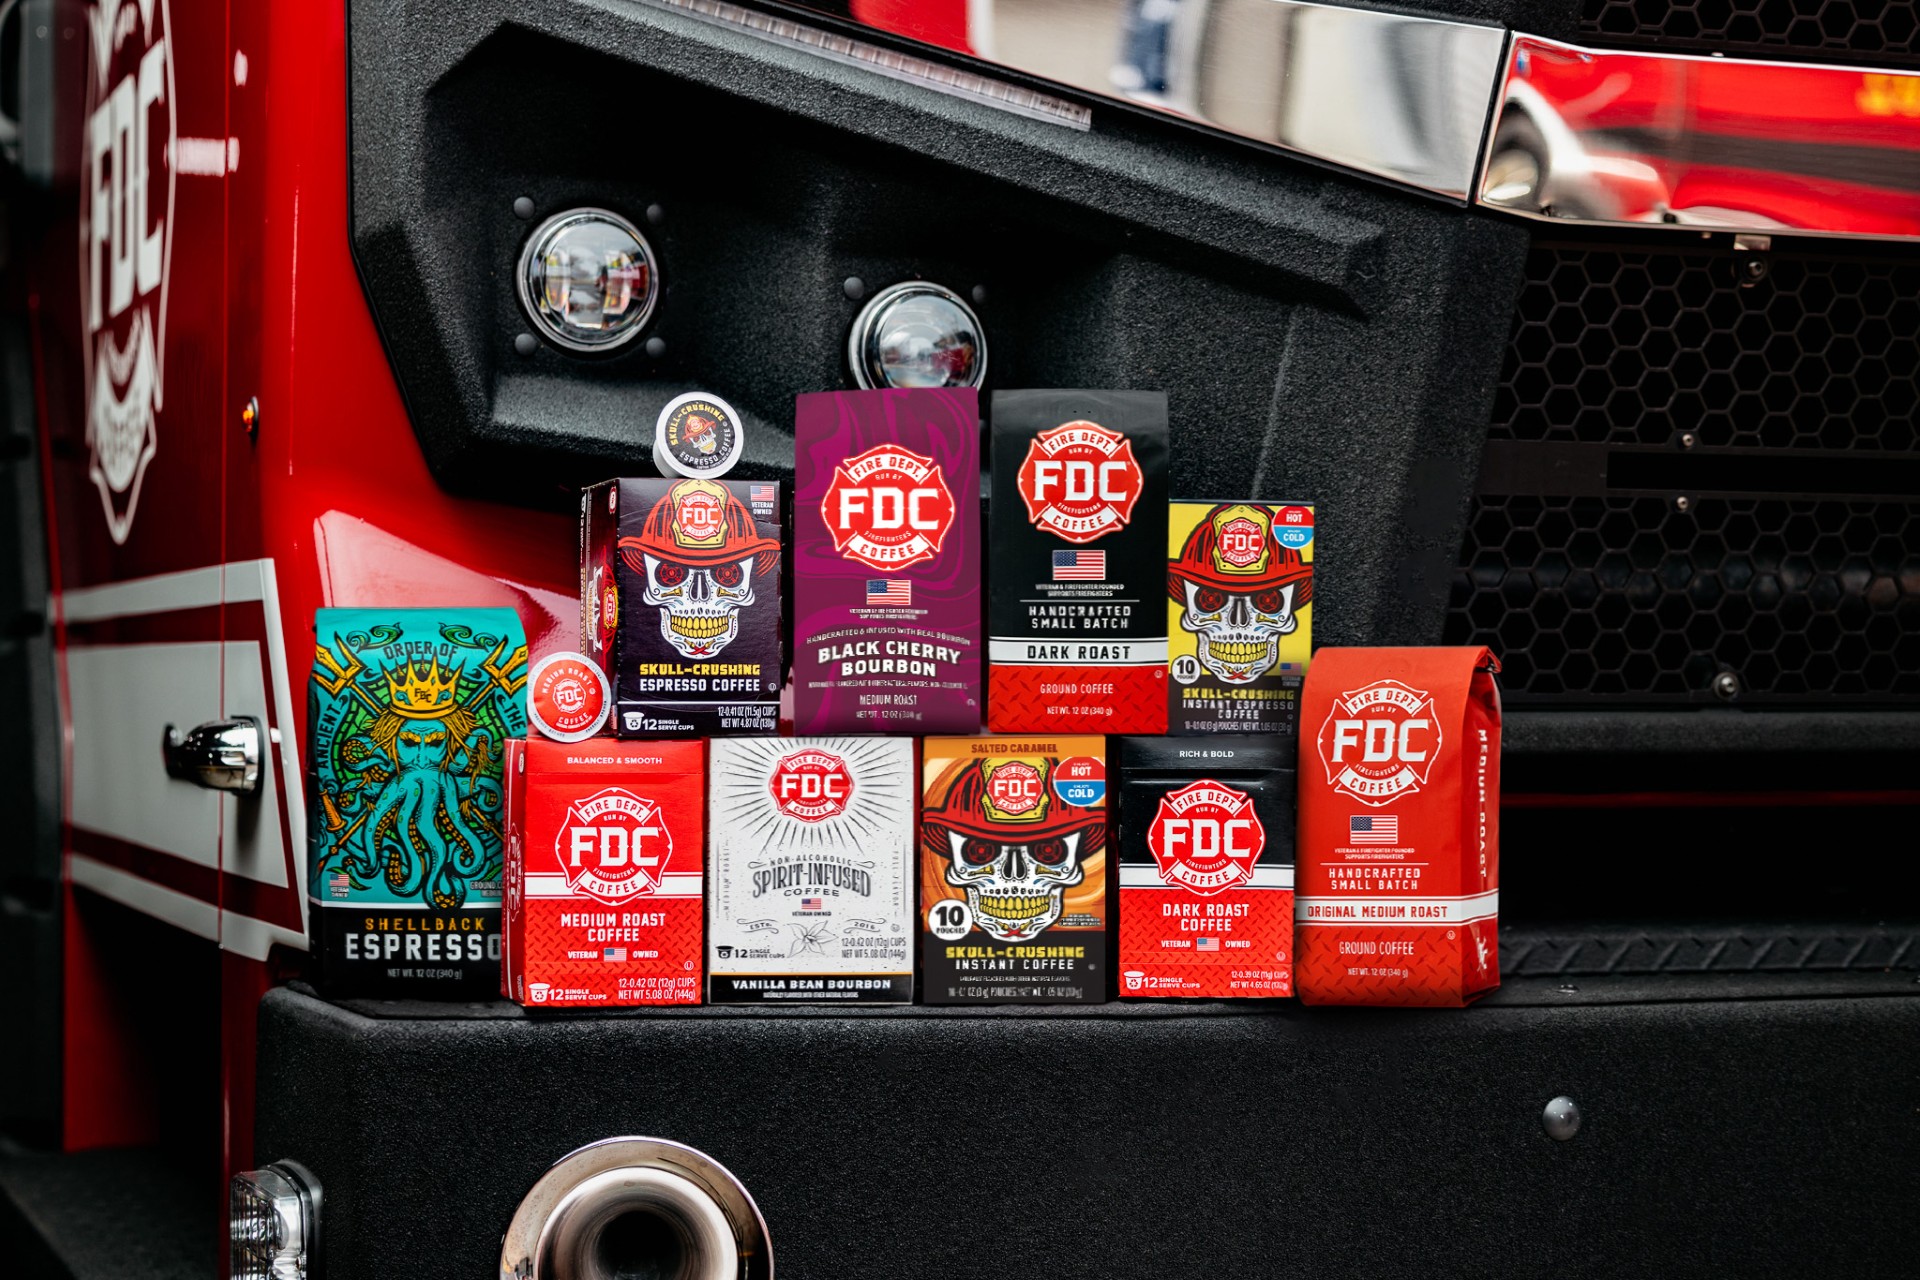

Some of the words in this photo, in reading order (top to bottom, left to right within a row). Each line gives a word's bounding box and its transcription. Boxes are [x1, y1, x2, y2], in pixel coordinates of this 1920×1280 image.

[90, 38, 164, 332] FDC
[668, 403, 725, 446] SKULL-CRUSHING
[680, 452, 719, 466] ESPRESSO
[719, 429, 731, 457] COFFEE
[1049, 432, 1074, 450] FIRE
[1082, 432, 1110, 451] DEPT.
[854, 458, 881, 477] FIRE
[890, 457, 920, 477] DEPT.
[1033, 461, 1127, 501] FDC
[839, 487, 939, 529] FDC
[1057, 502, 1101, 514] FIREFIGHTERS
[682, 508, 719, 524] FDC
[1286, 514, 1303, 522] HOT
[1053, 516, 1104, 530] COFFEE
[864, 531, 912, 542] FIREFIGHTERS
[1223, 534, 1260, 550] FDC
[1283, 533, 1305, 541] COLD
[860, 544, 915, 558] COFFEE
[1029, 606, 1131, 616] HANDCRAFTED
[1032, 618, 1075, 628] SMALL
[1084, 618, 1128, 628] BATCH
[807, 629, 859, 644] HANDCRAFTED
[917, 629, 934, 638] REAL
[383, 641, 433, 660] ORDER
[440, 646, 458, 659] OF
[818, 641, 880, 663] BLACK
[886, 641, 960, 664] CHERRY
[1028, 646, 1069, 659] DARK
[1078, 646, 1130, 659] ROAST
[640, 664, 760, 675] SKULL-CRUSHING
[842, 659, 936, 677] BOURBON
[1177, 660, 1195, 674] 10
[542, 668, 564, 693] MEDIUM
[568, 668, 592, 685] ROAST
[640, 679, 707, 691] ESPRESSO
[712, 679, 760, 691] COFFEE
[1040, 684, 1076, 693] GROUND
[1081, 684, 1113, 693] COFFEE
[1183, 688, 1294, 699] SKULL-CRUSHING
[557, 689, 582, 704] FDC
[860, 695, 891, 705] MEDIUM
[894, 695, 917, 705] ROAST
[1352, 691, 1379, 710] FIRE
[1386, 690, 1414, 710] DEPT.
[1183, 700, 1230, 708] INSTANT
[1236, 701, 1294, 709] ESPRESSO
[504, 702, 526, 732] THE
[559, 713, 589, 724] COFFEE
[1218, 710, 1259, 719] COFFEE
[644, 719, 657, 730] 12
[317, 704, 340, 769] ANCIENT
[1331, 719, 1429, 762] FDC
[972, 744, 1008, 753] SALTED
[1010, 744, 1058, 753] CARAMEL
[790, 758, 809, 768] FIRE
[812, 757, 831, 768] DEPT.
[1071, 767, 1091, 776] HOT
[1355, 763, 1399, 776] FIREFIGHTERS
[780, 774, 843, 797] FDC
[994, 780, 1036, 796] FDC
[1349, 777, 1402, 794] COFFEE
[1068, 789, 1094, 798] COLD
[1177, 792, 1201, 809] FIRE
[1208, 792, 1233, 810] DEPT.
[585, 800, 609, 817] FIRE
[616, 800, 642, 817] DEPT.
[793, 805, 828, 815] COFFEE
[1162, 819, 1251, 857] FDC
[570, 827, 659, 866] FDC
[770, 855, 852, 866] NON-ALCOHOLIC
[1186, 859, 1227, 870] FIREFIGHTERS
[593, 868, 635, 879] FIREFIGHTERS
[1182, 871, 1230, 885] COFFEE
[1329, 868, 1421, 878] HANDCRAFTED
[752, 863, 871, 898] SPIRIT-INFUSED
[1332, 880, 1371, 890] SMALL
[1379, 880, 1418, 890] BATCH
[589, 881, 637, 894] COFFEE
[784, 888, 839, 897] COFFEE
[935, 906, 964, 926] 10
[1163, 904, 1200, 916] DARK
[1207, 904, 1249, 916] ROAST
[1308, 906, 1356, 917] ORIGINAL
[1362, 906, 1405, 918] MEDIUM
[1411, 907, 1447, 917] ROAST
[365, 918, 485, 931] SHELLBACK
[561, 913, 616, 926] MEDIUM
[622, 913, 665, 926] ROAST
[1181, 919, 1231, 931] COFFEE
[854, 922, 875, 930] 2016
[588, 929, 639, 942] COFFEE
[345, 933, 502, 961] ESPRESSO
[842, 938, 865, 946] 12-0.42
[866, 938, 874, 946] OZ
[874, 937, 889, 947] (12g)
[891, 937, 906, 946] CUPS
[1161, 940, 1190, 948] VETERAN
[1225, 940, 1250, 948] OWNED
[1339, 942, 1376, 954] GROUND
[1379, 942, 1414, 954] COFFEE
[735, 949, 747, 958] 12
[946, 947, 1084, 958] SKULL-CRUSHING
[956, 960, 1014, 969] INSTANT
[1024, 960, 1074, 969] COFFEE
[618, 978, 646, 987] 12-0.42
[648, 978, 656, 987] OZ
[658, 978, 675, 989] (12g)
[678, 977, 695, 987] CUPS
[732, 980, 785, 989] VANILLA
[790, 980, 823, 989] BEAN
[828, 980, 891, 989] BOURBON
[1143, 978, 1158, 988] 12
[549, 989, 563, 1000] 12
[618, 990, 632, 999] NET
[634, 990, 644, 999] WT
[646, 990, 663, 999] 5.08
[664, 990, 673, 999] OZ
[675, 989, 695, 1000] (144g)
